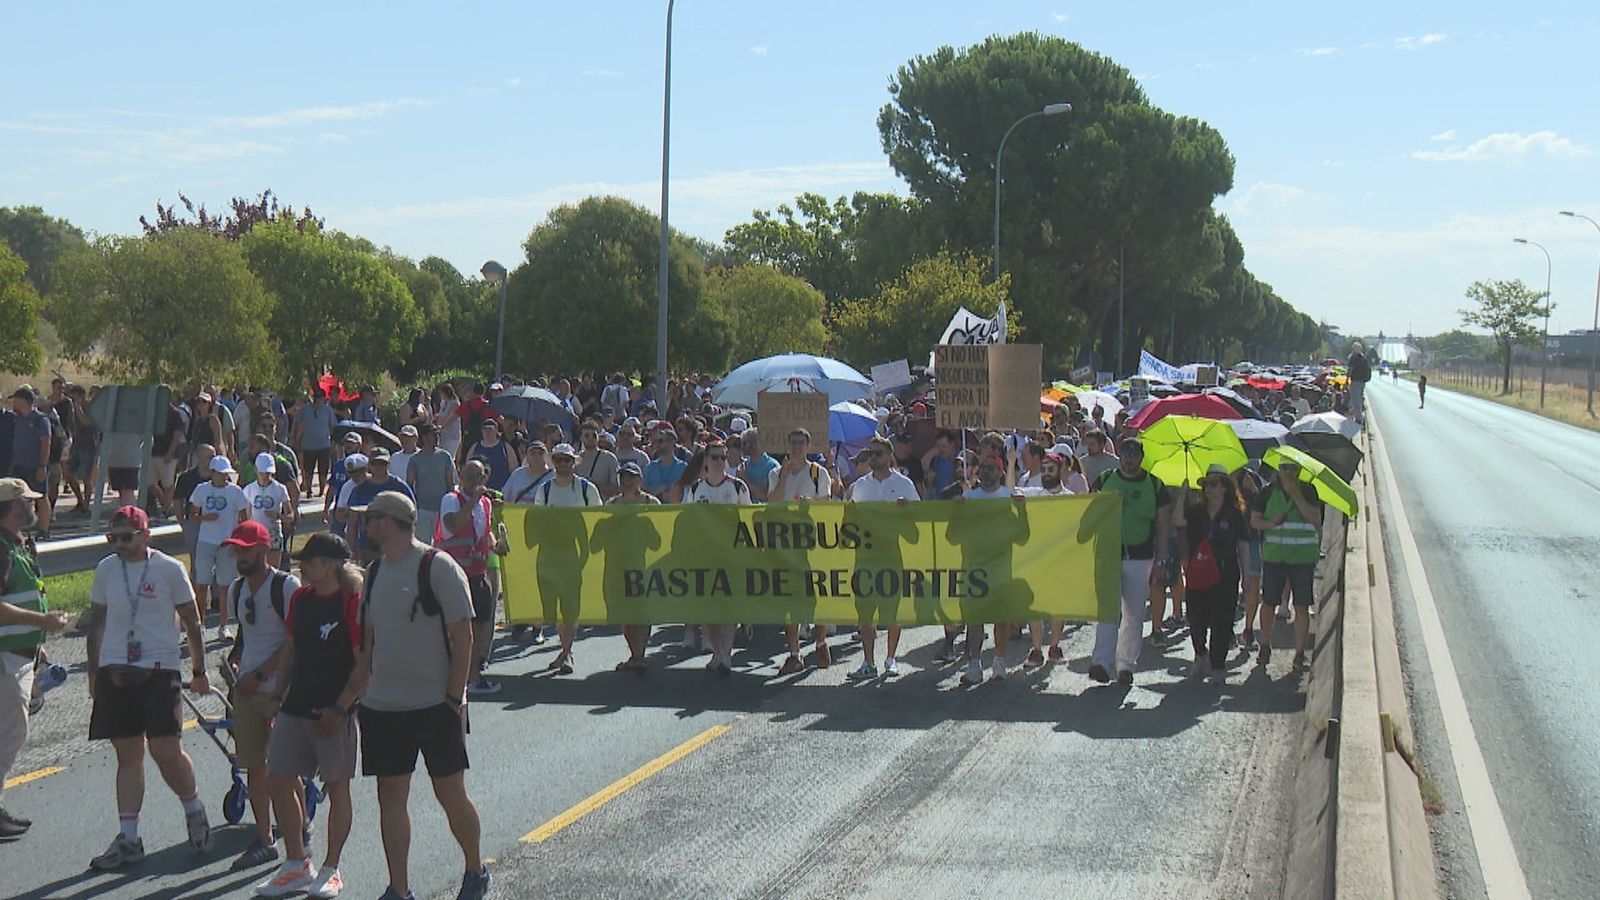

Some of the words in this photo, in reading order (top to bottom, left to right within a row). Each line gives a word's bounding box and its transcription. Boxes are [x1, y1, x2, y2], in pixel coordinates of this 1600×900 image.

[951, 346, 966, 363] NO
[734, 522, 872, 549] AIRBUS:
[624, 569, 732, 597] BASTA
[746, 569, 793, 597] DE
[804, 568, 989, 598] RECORTES
